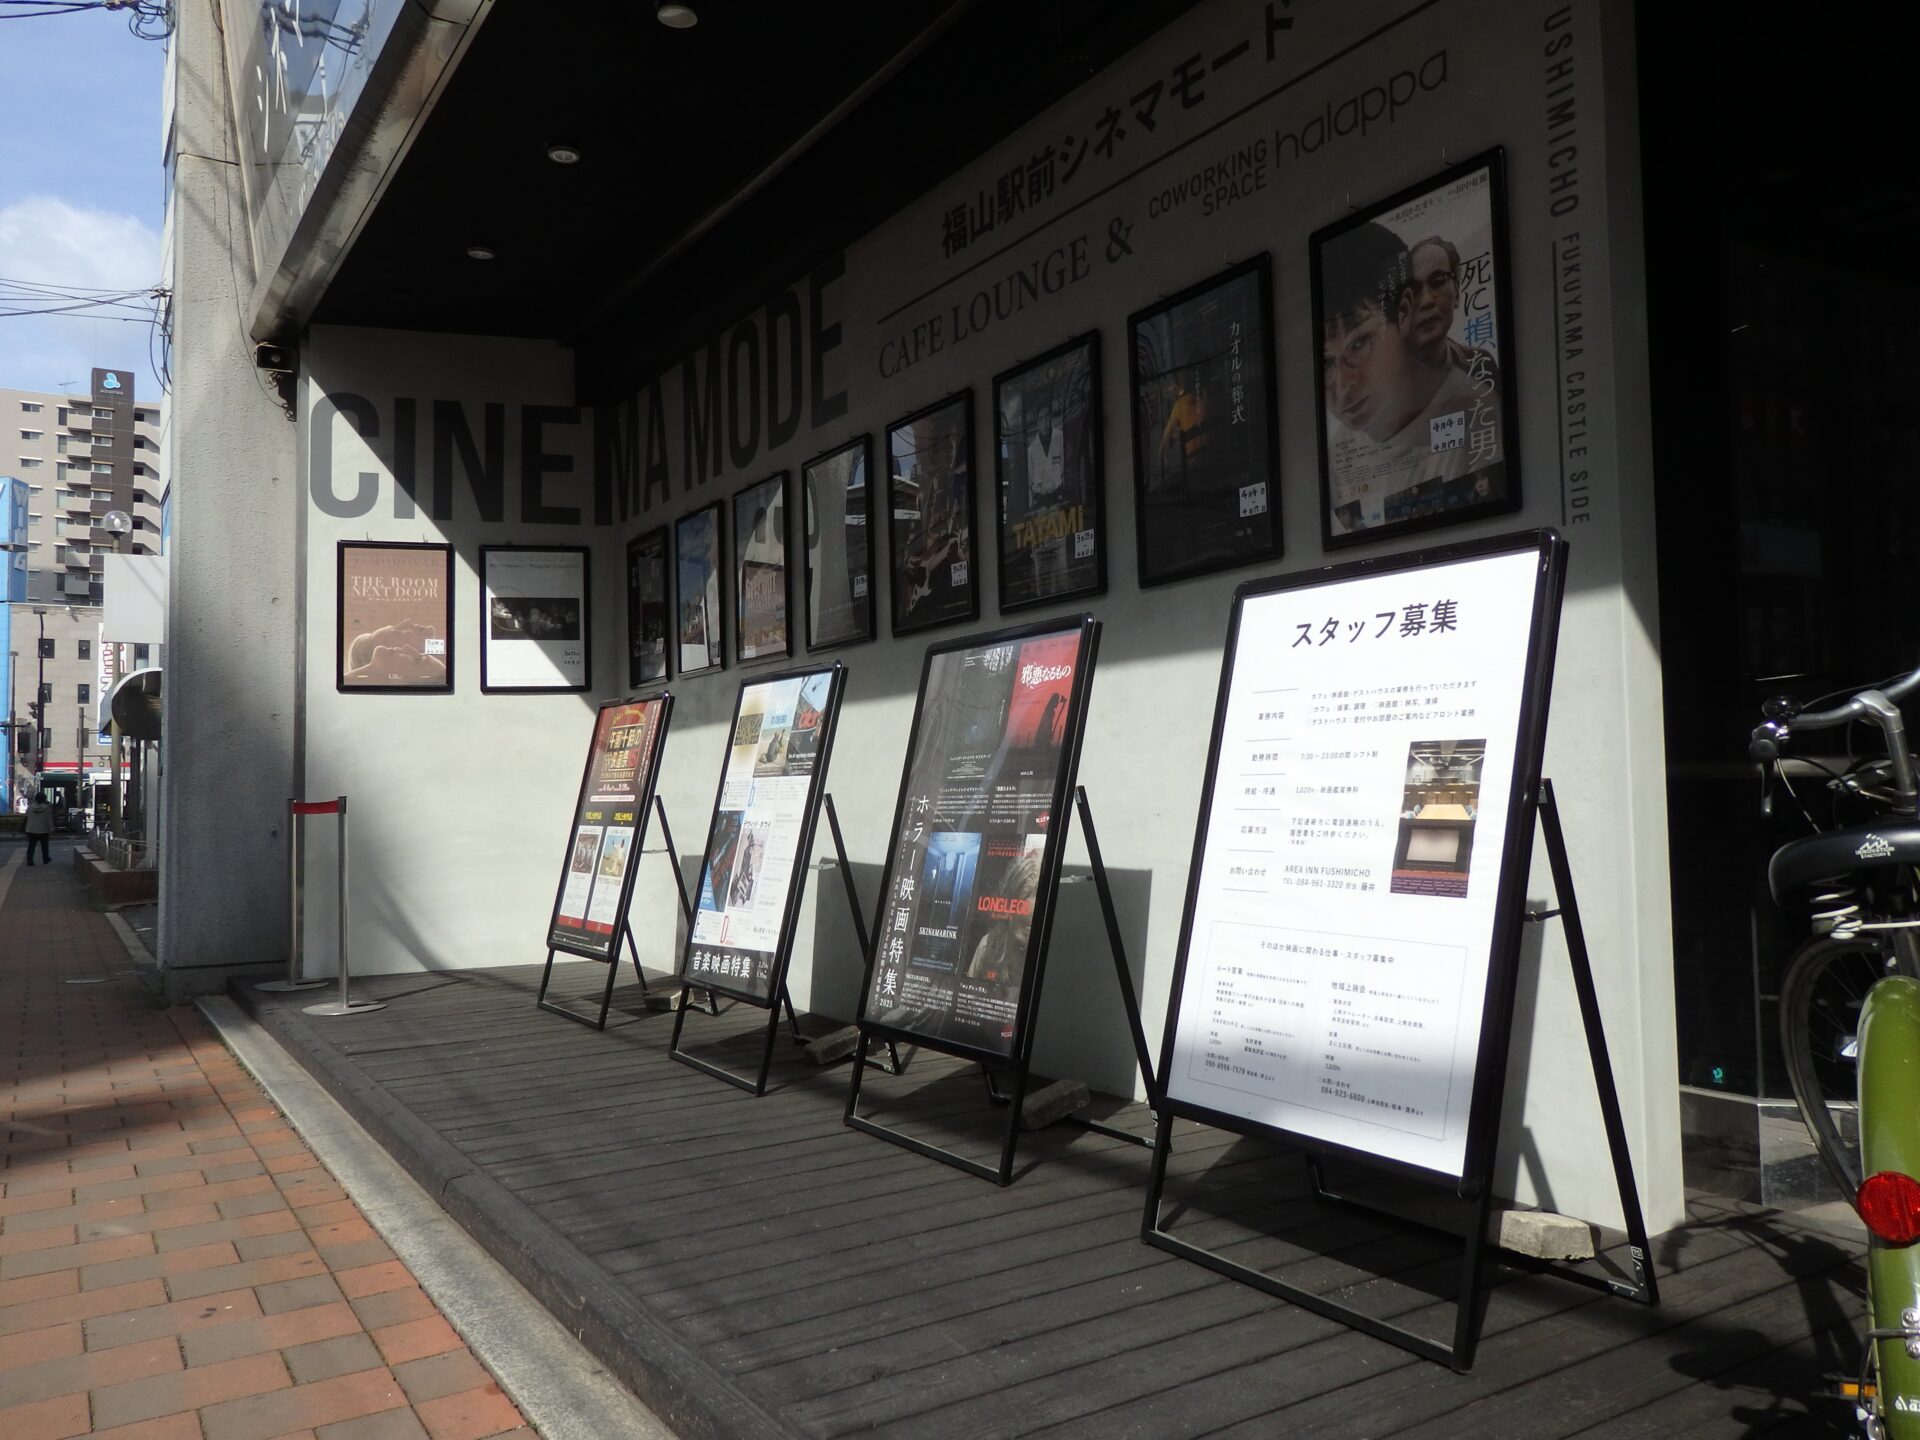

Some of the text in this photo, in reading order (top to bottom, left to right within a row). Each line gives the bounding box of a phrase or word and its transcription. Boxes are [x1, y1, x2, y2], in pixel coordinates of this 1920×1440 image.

[942, 0, 1295, 259] 福山駅前シネマモード
[1275, 49, 1448, 168] halappa
[1543, 0, 1580, 219] USHIMICHO
[1148, 138, 1267, 219] COWORKING
[1202, 167, 1267, 217] SPACE
[878, 216, 1134, 379] CAFE LOUNGE &
[1230, 321, 1246, 425] カオルの葬式
[1459, 251, 1497, 465] 死に損なった男
[1561, 232, 1590, 524] FUKUYAMA CASTLE SIDE
[309, 250, 849, 526] CINEMA MODE
[1012, 504, 1084, 550] TATAMI
[352, 576, 438, 588] THE ROOM
[353, 586, 438, 598] NEXT DOOR
[1292, 599, 1458, 647] スタッフ募集
[1020, 663, 1071, 687] 邪悪なるもの
[1257, 711, 1285, 721] 業務内容
[1251, 752, 1279, 762] 勤務時間
[1229, 866, 1267, 877] お問い合わせ
[1284, 865, 1371, 878] AREA INN FUSHIMICHO
[882, 795, 930, 997] ホラー映画特集
[918, 926, 958, 940] SKINAMARINK
[693, 949, 752, 979] 音楽映画特集
[1331, 981, 1366, 994] 地域上映会
